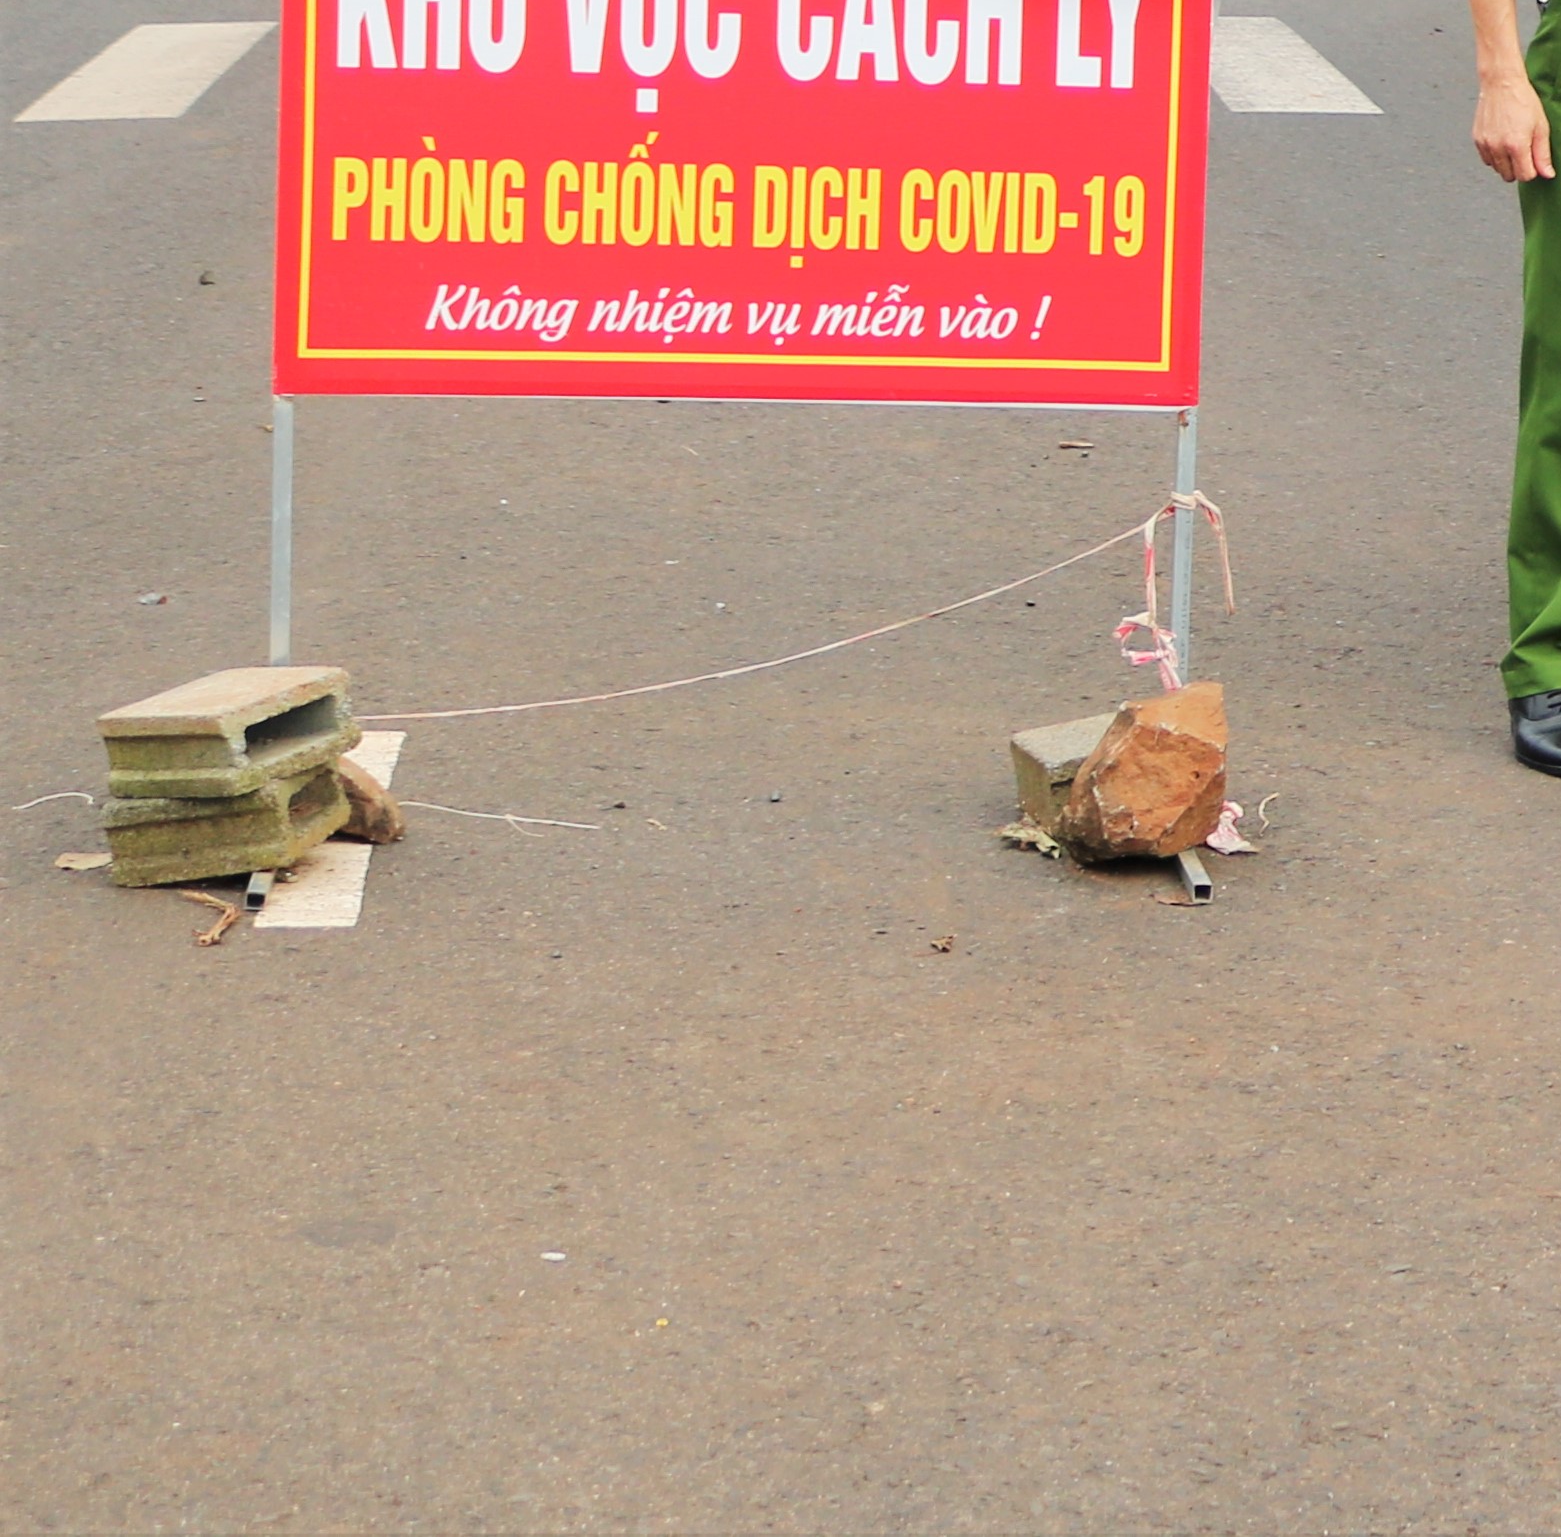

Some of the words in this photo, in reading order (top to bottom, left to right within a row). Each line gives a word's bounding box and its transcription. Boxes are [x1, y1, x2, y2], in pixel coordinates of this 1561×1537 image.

[332, 136, 525, 243] PHÒNG
[544, 132, 733, 247] CHỐNG
[754, 165, 880, 268] DỊCH
[900, 169, 1145, 258] COVID-19
[426, 284, 575, 342] Không
[587, 288, 731, 344] nhiệm
[748, 303, 801, 346] vụ
[812, 284, 924, 338] miễn
[940, 294, 1018, 340] vào
[1032, 296, 1051, 341] !
